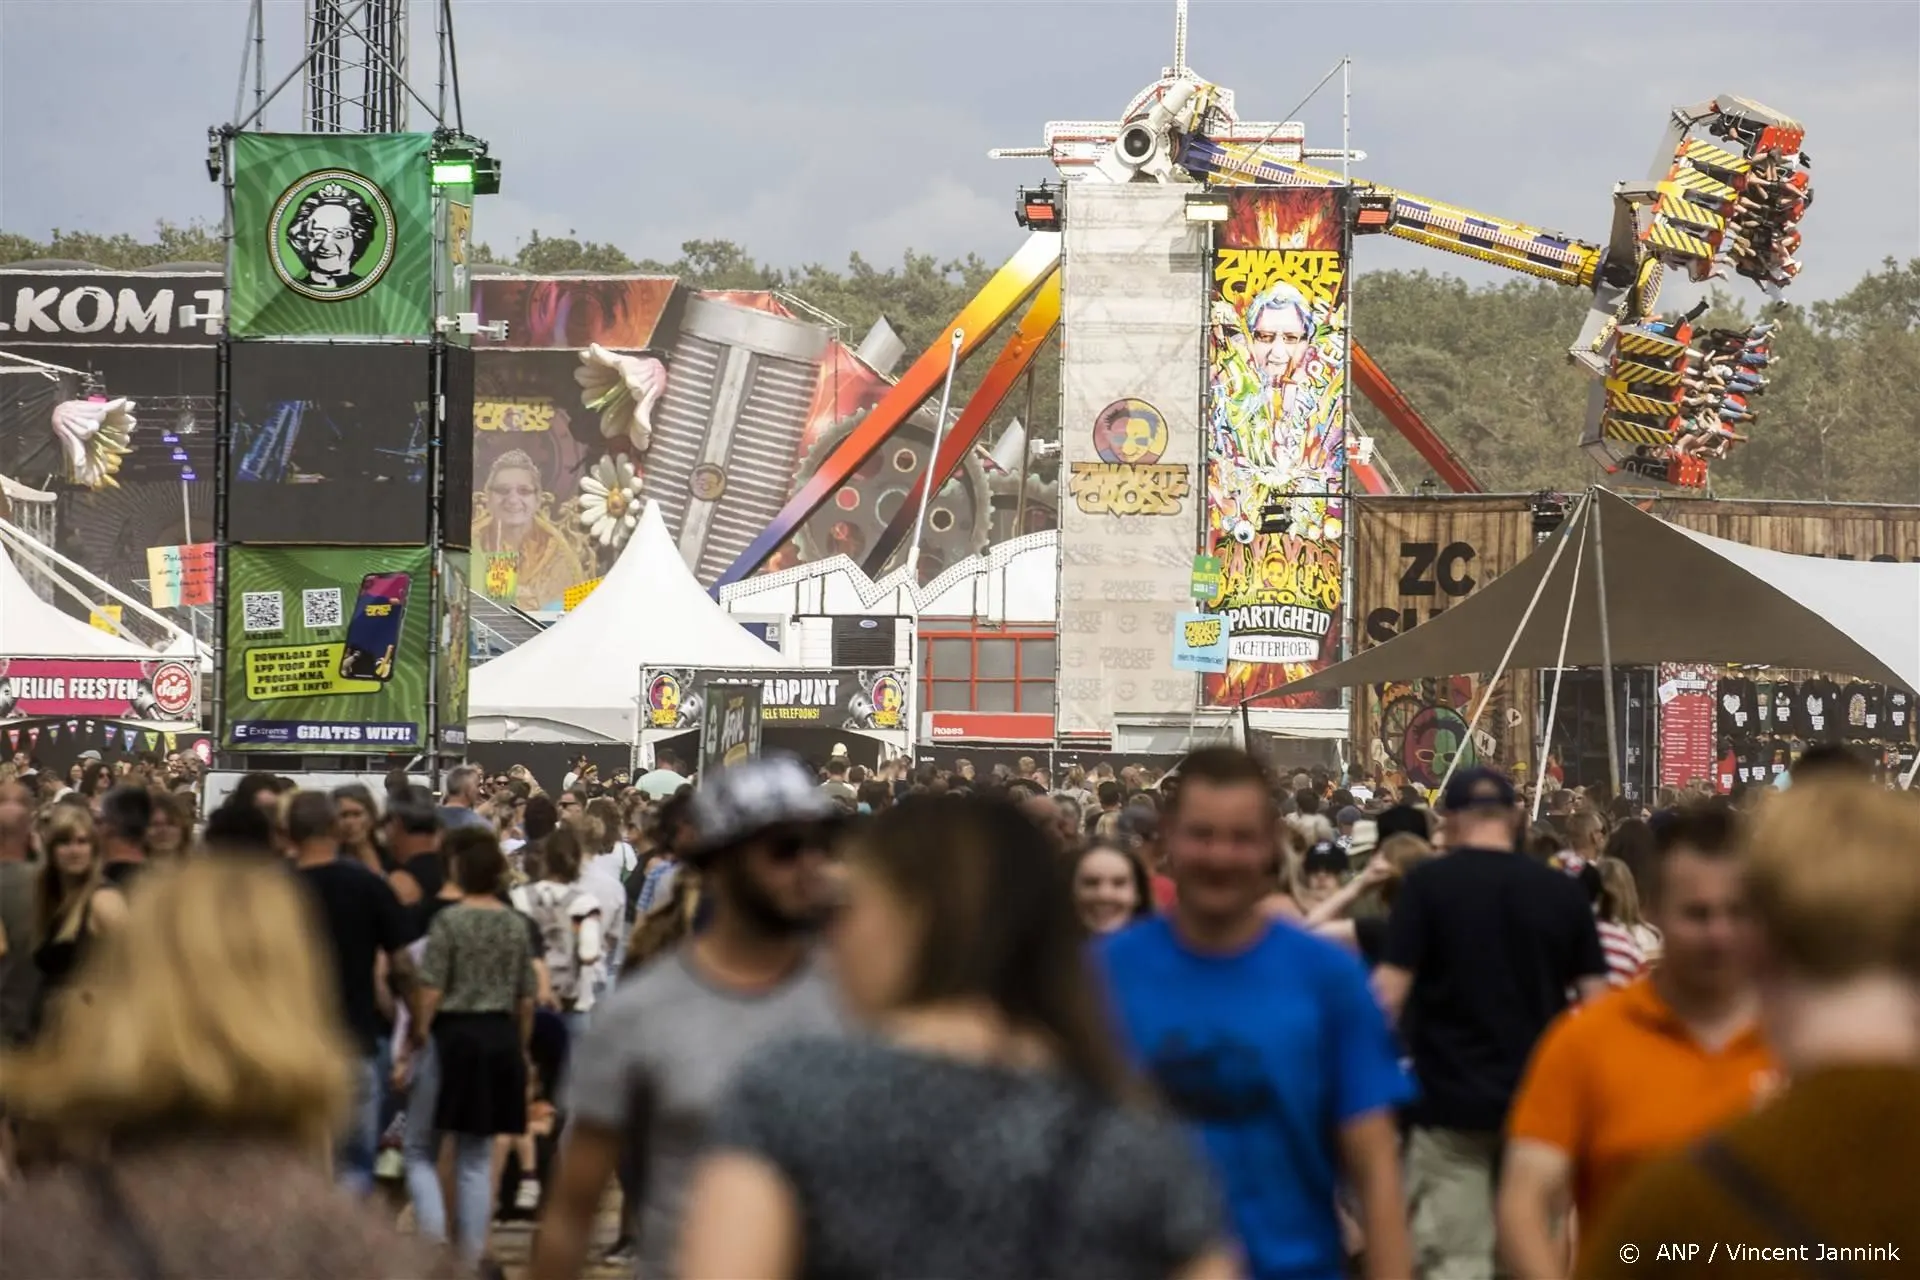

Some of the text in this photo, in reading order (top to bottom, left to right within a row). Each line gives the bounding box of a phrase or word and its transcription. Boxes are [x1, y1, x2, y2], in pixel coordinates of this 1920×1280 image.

[1215, 249, 1344, 281] ZWARTE
[1222, 273, 1344, 307] CROSS
[0, 286, 174, 334] KOM
[1069, 462, 1190, 497] ZWARTE
[1077, 484, 1182, 518] CROSS
[1399, 541, 1476, 596] ZC
[1257, 590, 1296, 605] TO
[254, 649, 330, 662] DOWNLOAD DE
[1234, 641, 1312, 657] ACHTERHOEK
[254, 660, 330, 673] APP VOOR HET
[257, 671, 324, 684] PROGRAMMA
[9, 677, 65, 699] VEILIG
[69, 678, 139, 700] FEESTEN
[254, 681, 333, 695] EN MEER INFO!
[715, 678, 839, 706] ADPUNT
[762, 708, 820, 719] IELE TELEFOONS!
[249, 726, 289, 736] Extreme
[297, 725, 361, 740] GRATIS
[365, 726, 411, 740] WIFI!
